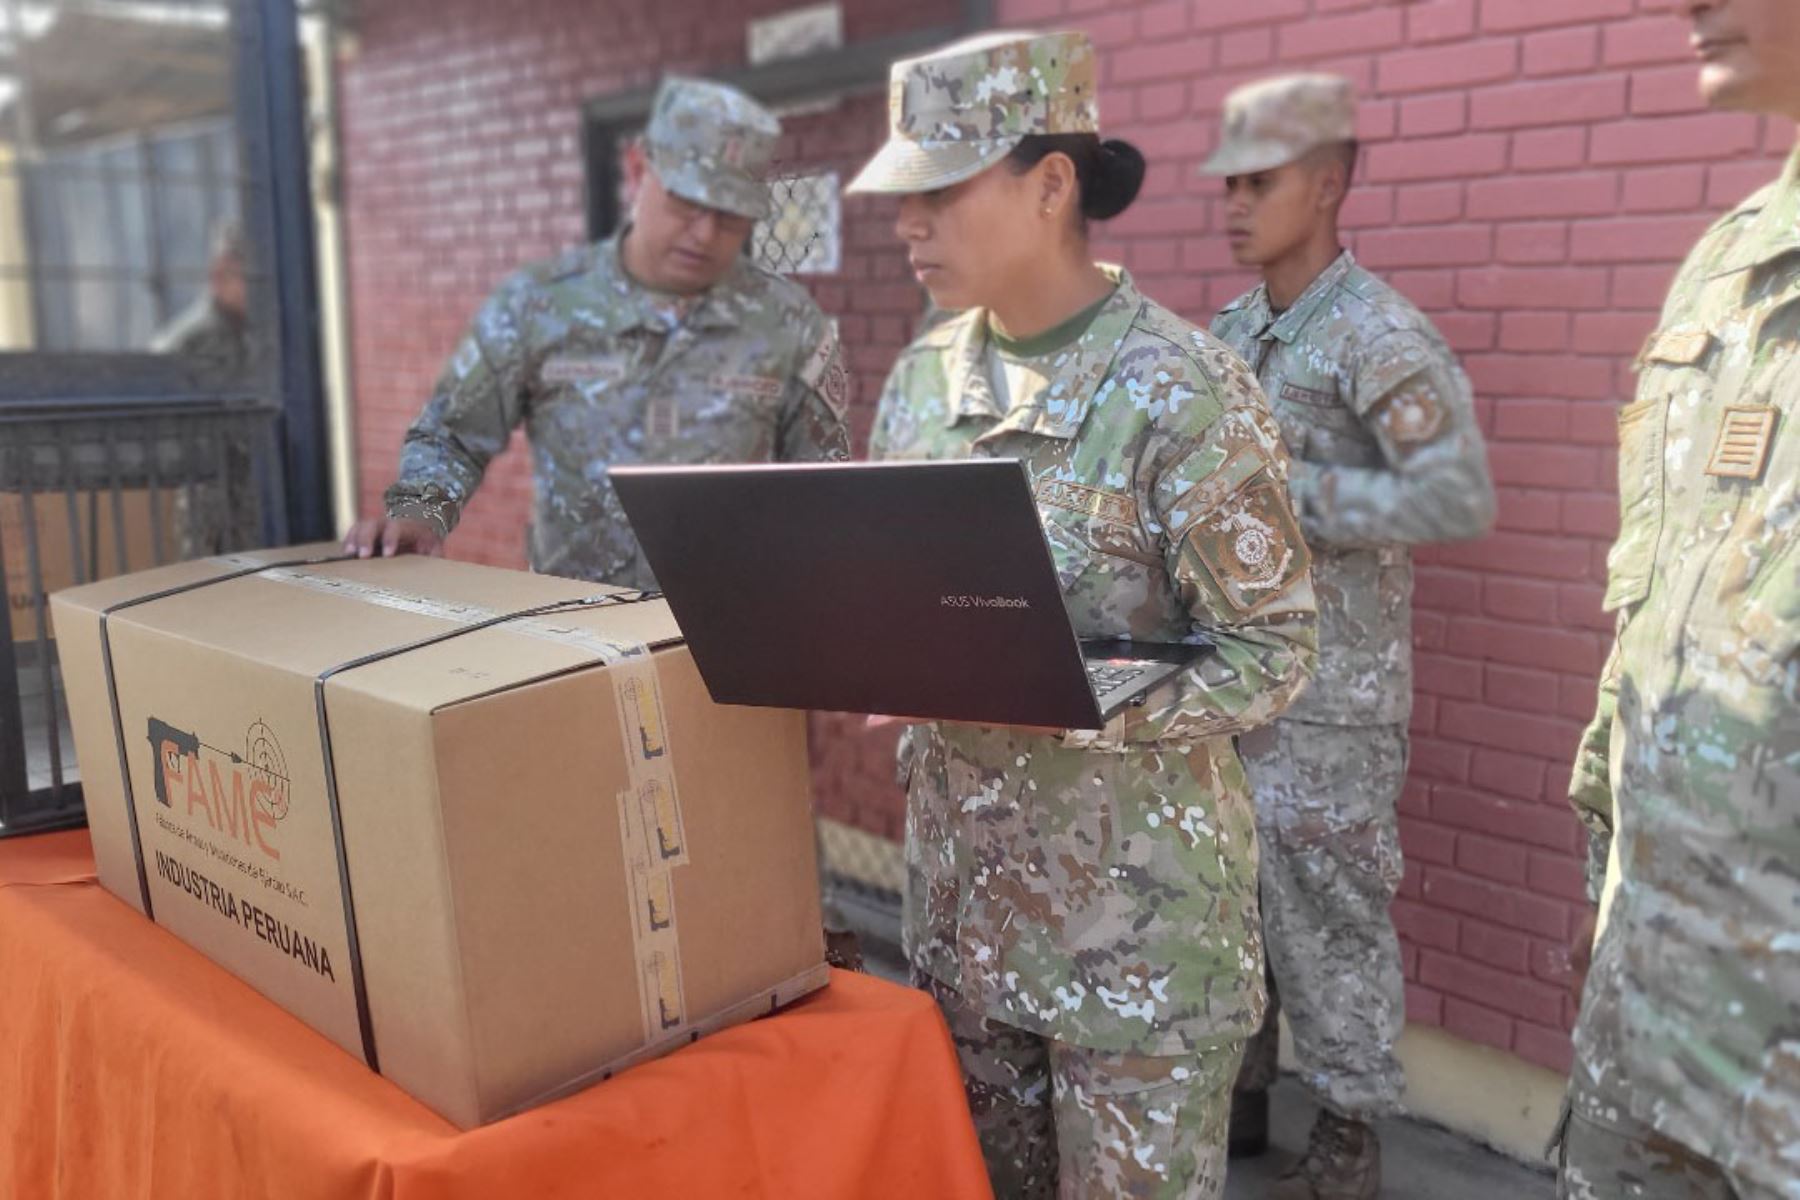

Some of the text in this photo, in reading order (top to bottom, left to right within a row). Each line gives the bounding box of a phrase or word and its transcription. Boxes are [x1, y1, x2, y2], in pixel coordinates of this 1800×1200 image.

[940, 594, 1030, 609] ASUS VivoBook
[160, 739, 284, 861] FAME
[155, 849, 336, 984] INDUSTRIA PERUANA
